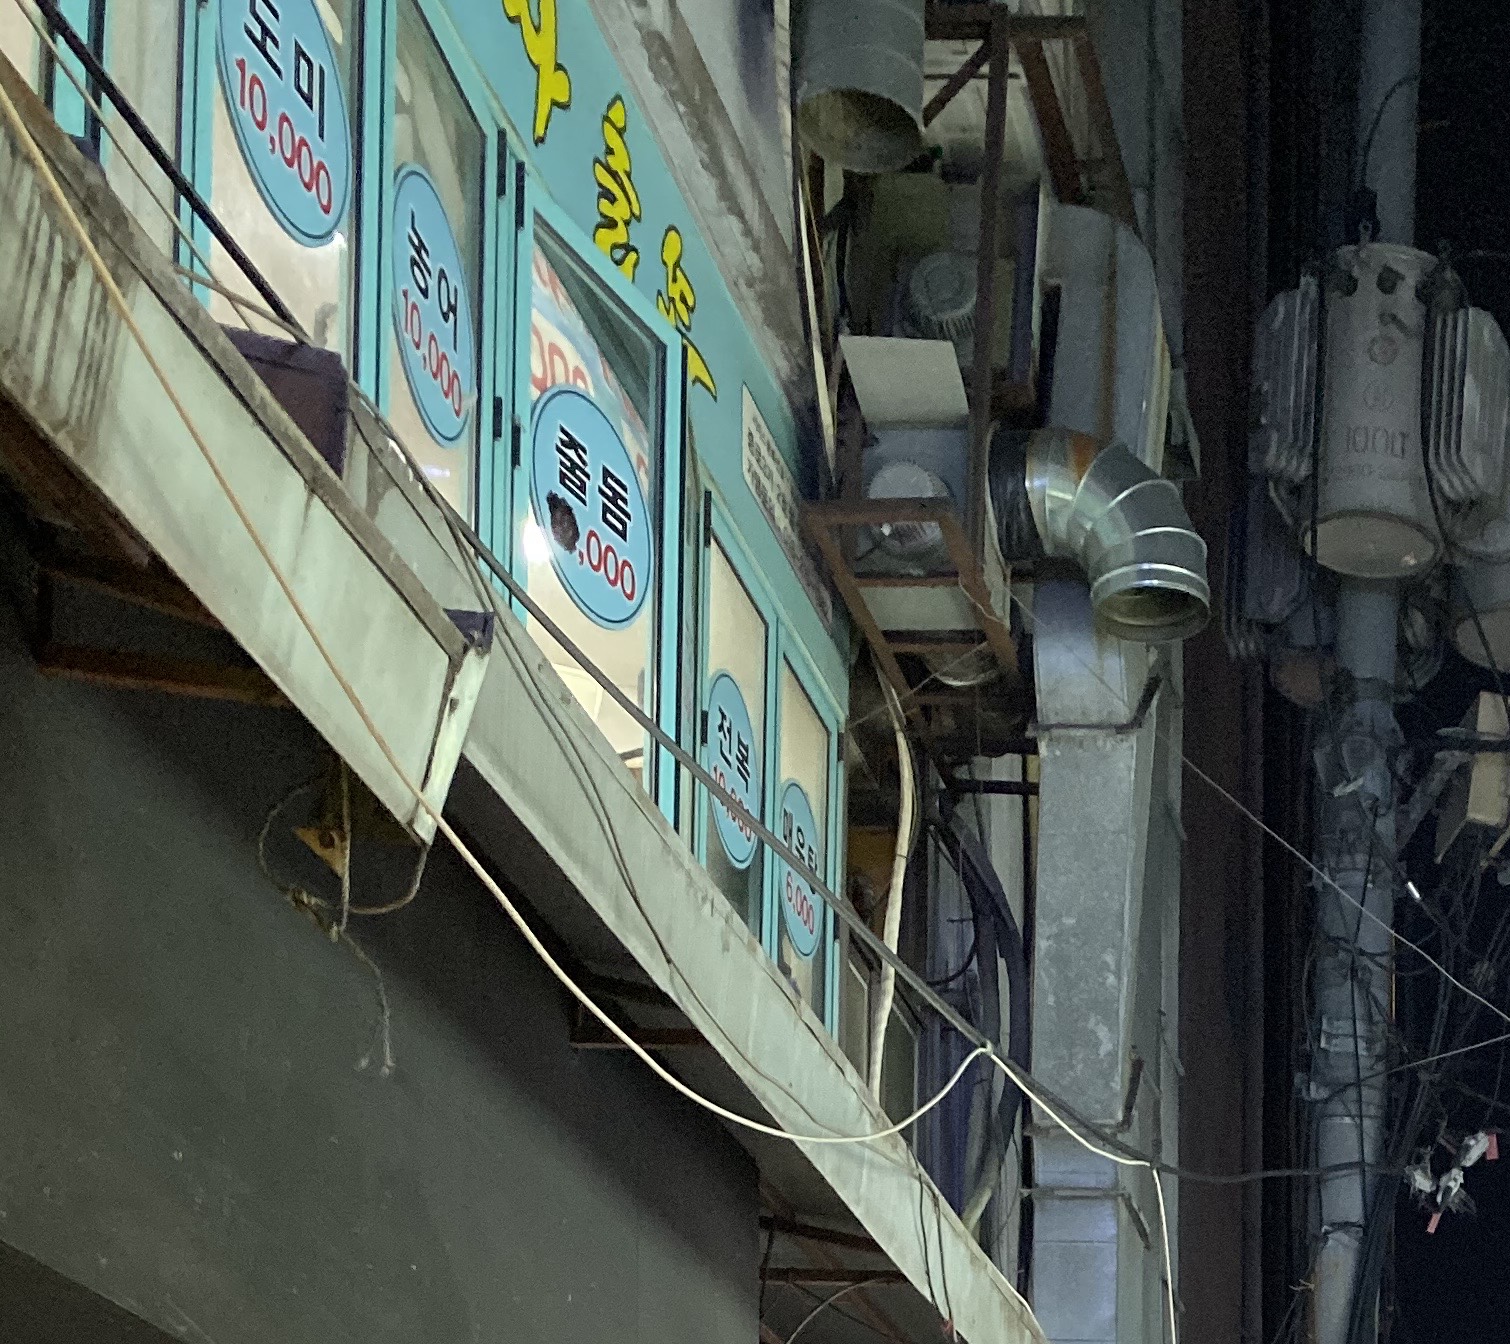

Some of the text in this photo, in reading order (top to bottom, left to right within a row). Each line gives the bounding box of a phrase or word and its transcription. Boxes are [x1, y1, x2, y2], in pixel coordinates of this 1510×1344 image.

[235, 58, 333, 216] 10,000
[409, 210, 460, 353] 농어
[402, 288, 462, 419] 10,000
[718, 705, 751, 794] 전복
[785, 871, 815, 936] 6,000
